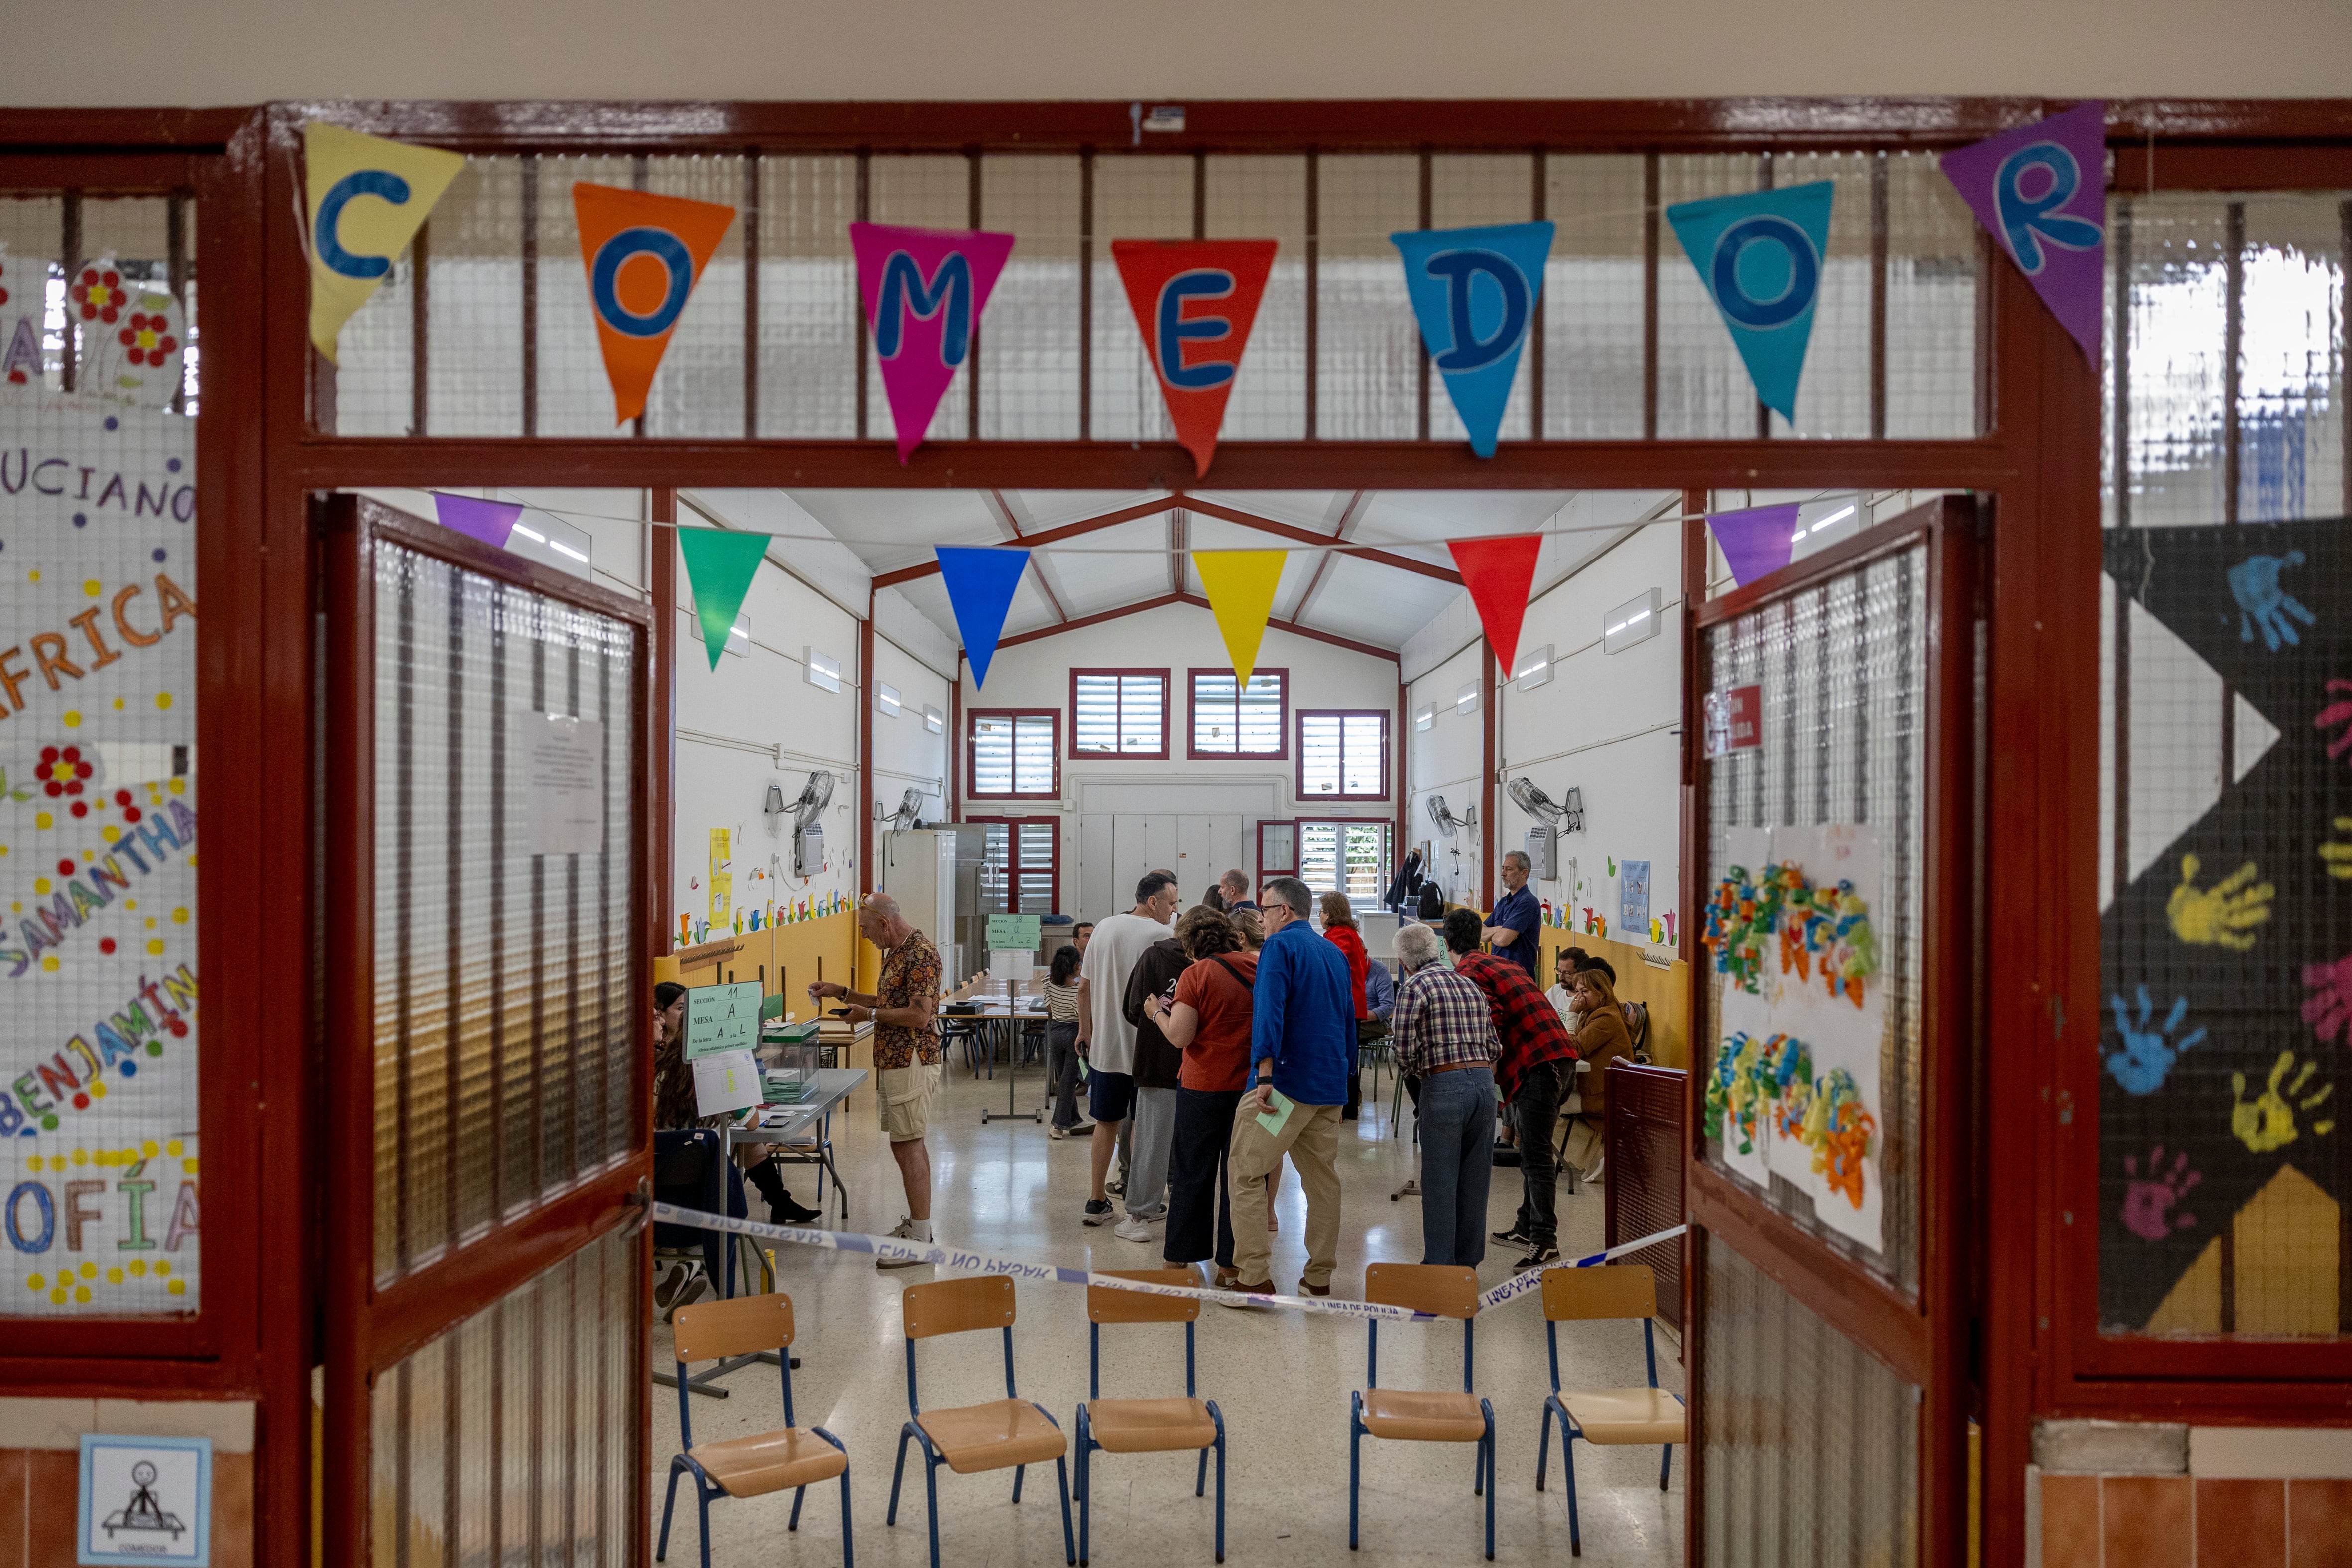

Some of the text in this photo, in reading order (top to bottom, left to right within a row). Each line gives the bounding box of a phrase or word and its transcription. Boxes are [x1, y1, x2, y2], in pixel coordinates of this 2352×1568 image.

[1166, 978, 1178, 993] 2
[693, 987, 737, 1005] SECCIÓN 11
[693, 1003, 735, 1025] MESA A
[717, 1027, 723, 1038] A
[740, 1024, 746, 1034] L
